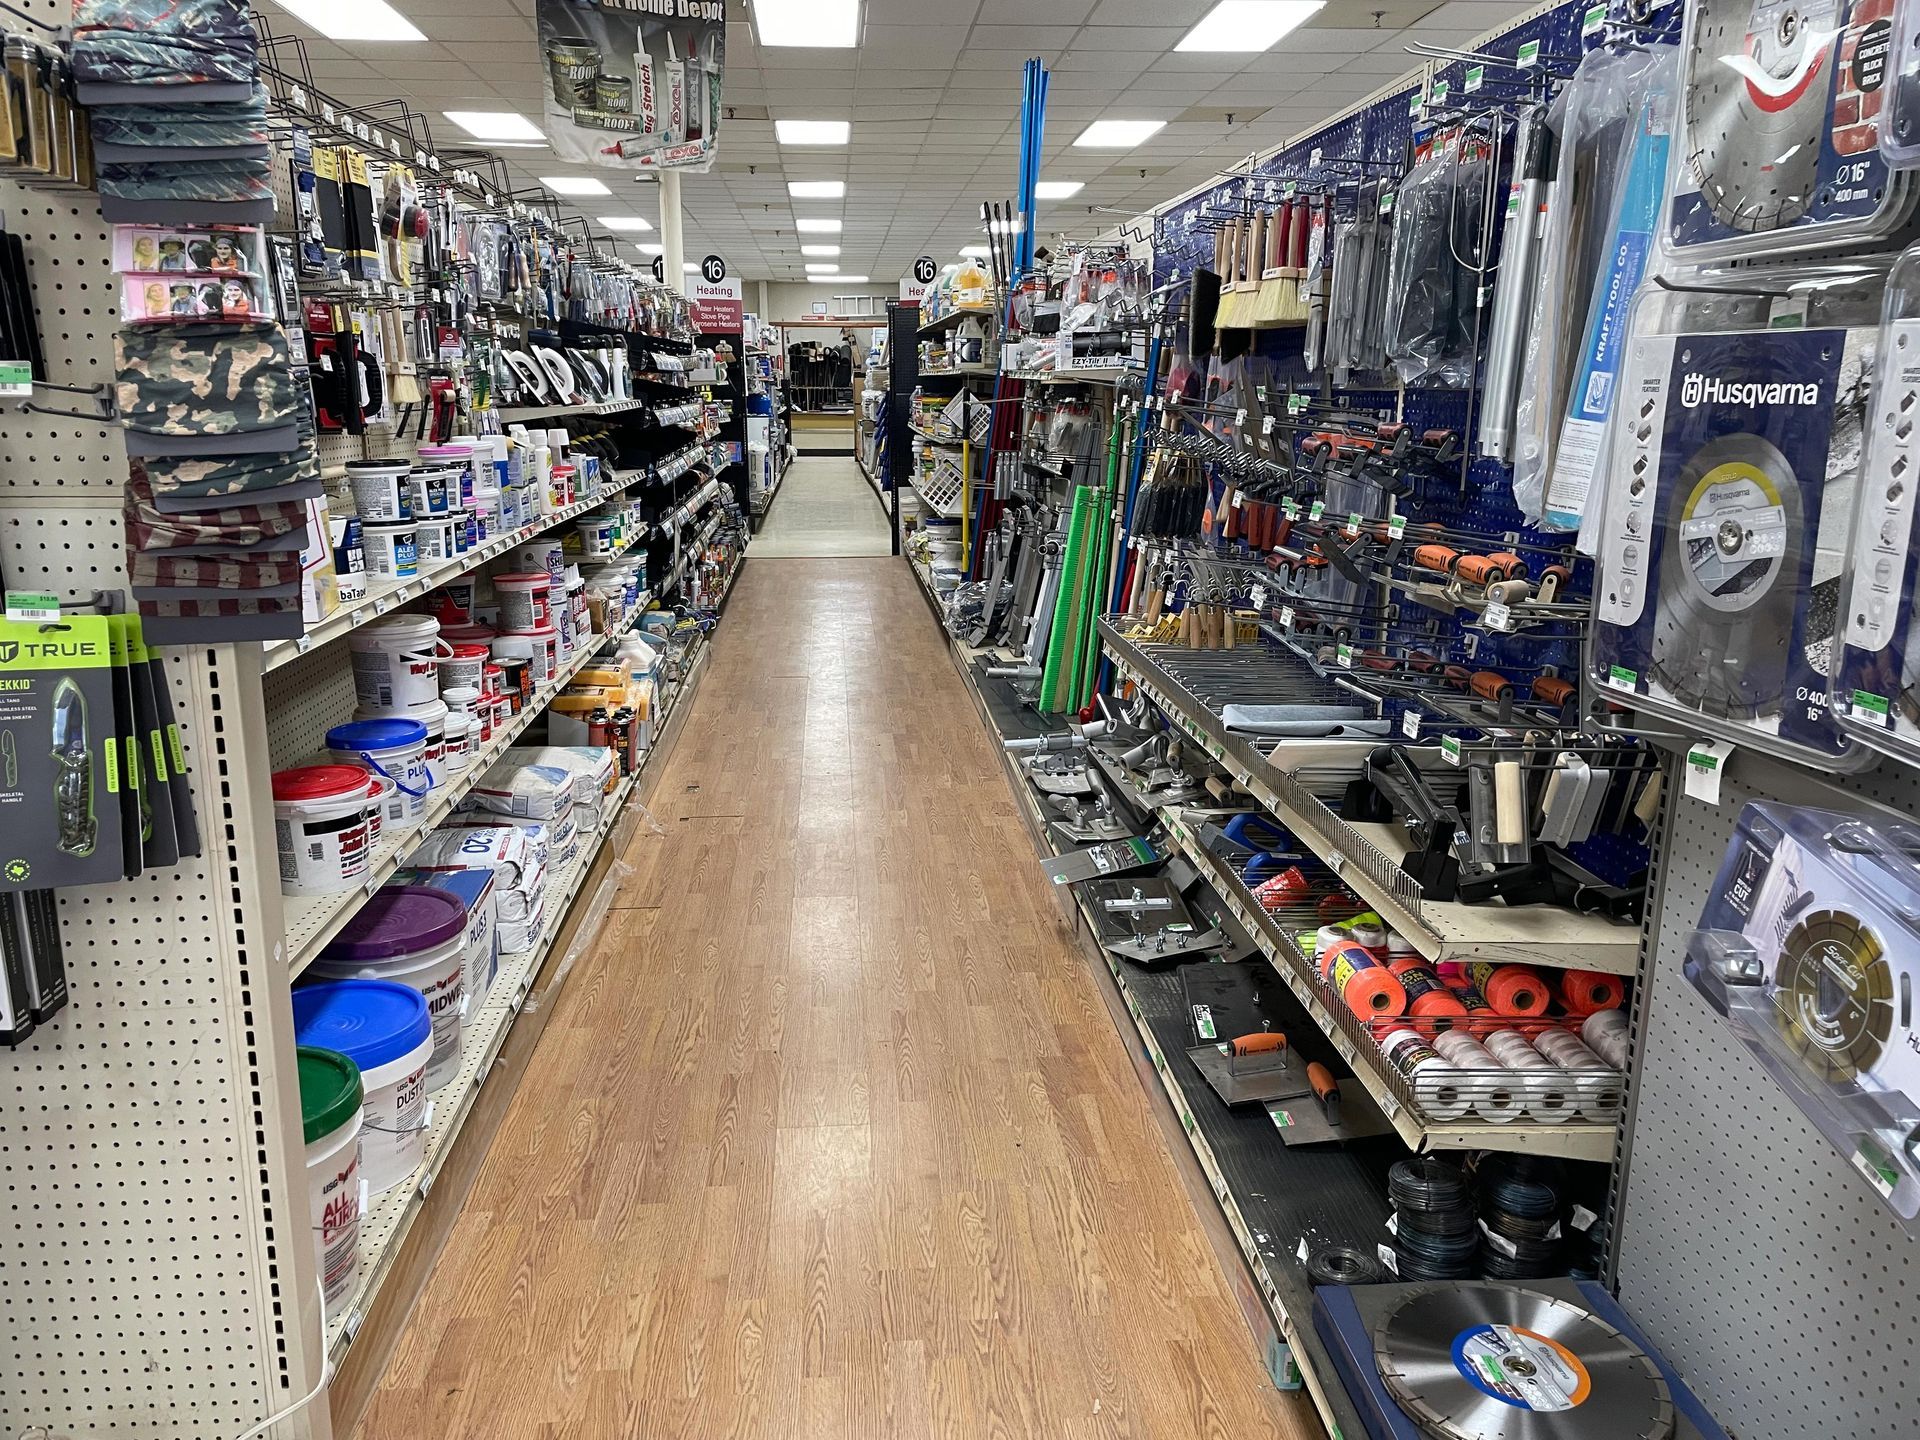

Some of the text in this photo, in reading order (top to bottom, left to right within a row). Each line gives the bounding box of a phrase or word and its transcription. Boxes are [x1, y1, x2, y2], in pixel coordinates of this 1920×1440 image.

[624, 0, 674, 16] Home
[677, 0, 723, 22] Depot
[1863, 57, 1883, 72] BLOCK
[1862, 72, 1881, 85] BRICK
[641, 64, 652, 111] Stretch
[644, 114, 656, 133] Big
[1834, 188, 1868, 202] 400 mm
[705, 260, 722, 279] 16
[917, 261, 934, 280] 16
[696, 286, 733, 297] Heating
[700, 313, 731, 321] Stove Pipe
[713, 305, 735, 313] Heaters
[1595, 312, 1609, 362] KRAFT
[1607, 271, 1622, 309] TOOL
[719, 320, 740, 328] Heaters
[1702, 377, 1819, 409] Husqvarna
[1716, 489, 1750, 501] Husqvarna
[24, 642, 96, 657] TRUE
[462, 838, 493, 853] 20
[1734, 884, 1749, 901] CUT
[1823, 945, 1865, 981] SOFF-CUT
[421, 984, 436, 996] USG
[396, 1081, 408, 1093] USG
[396, 1083, 419, 1109] DUST
[323, 1178, 338, 1195] USG
[323, 1191, 348, 1223] ALL
